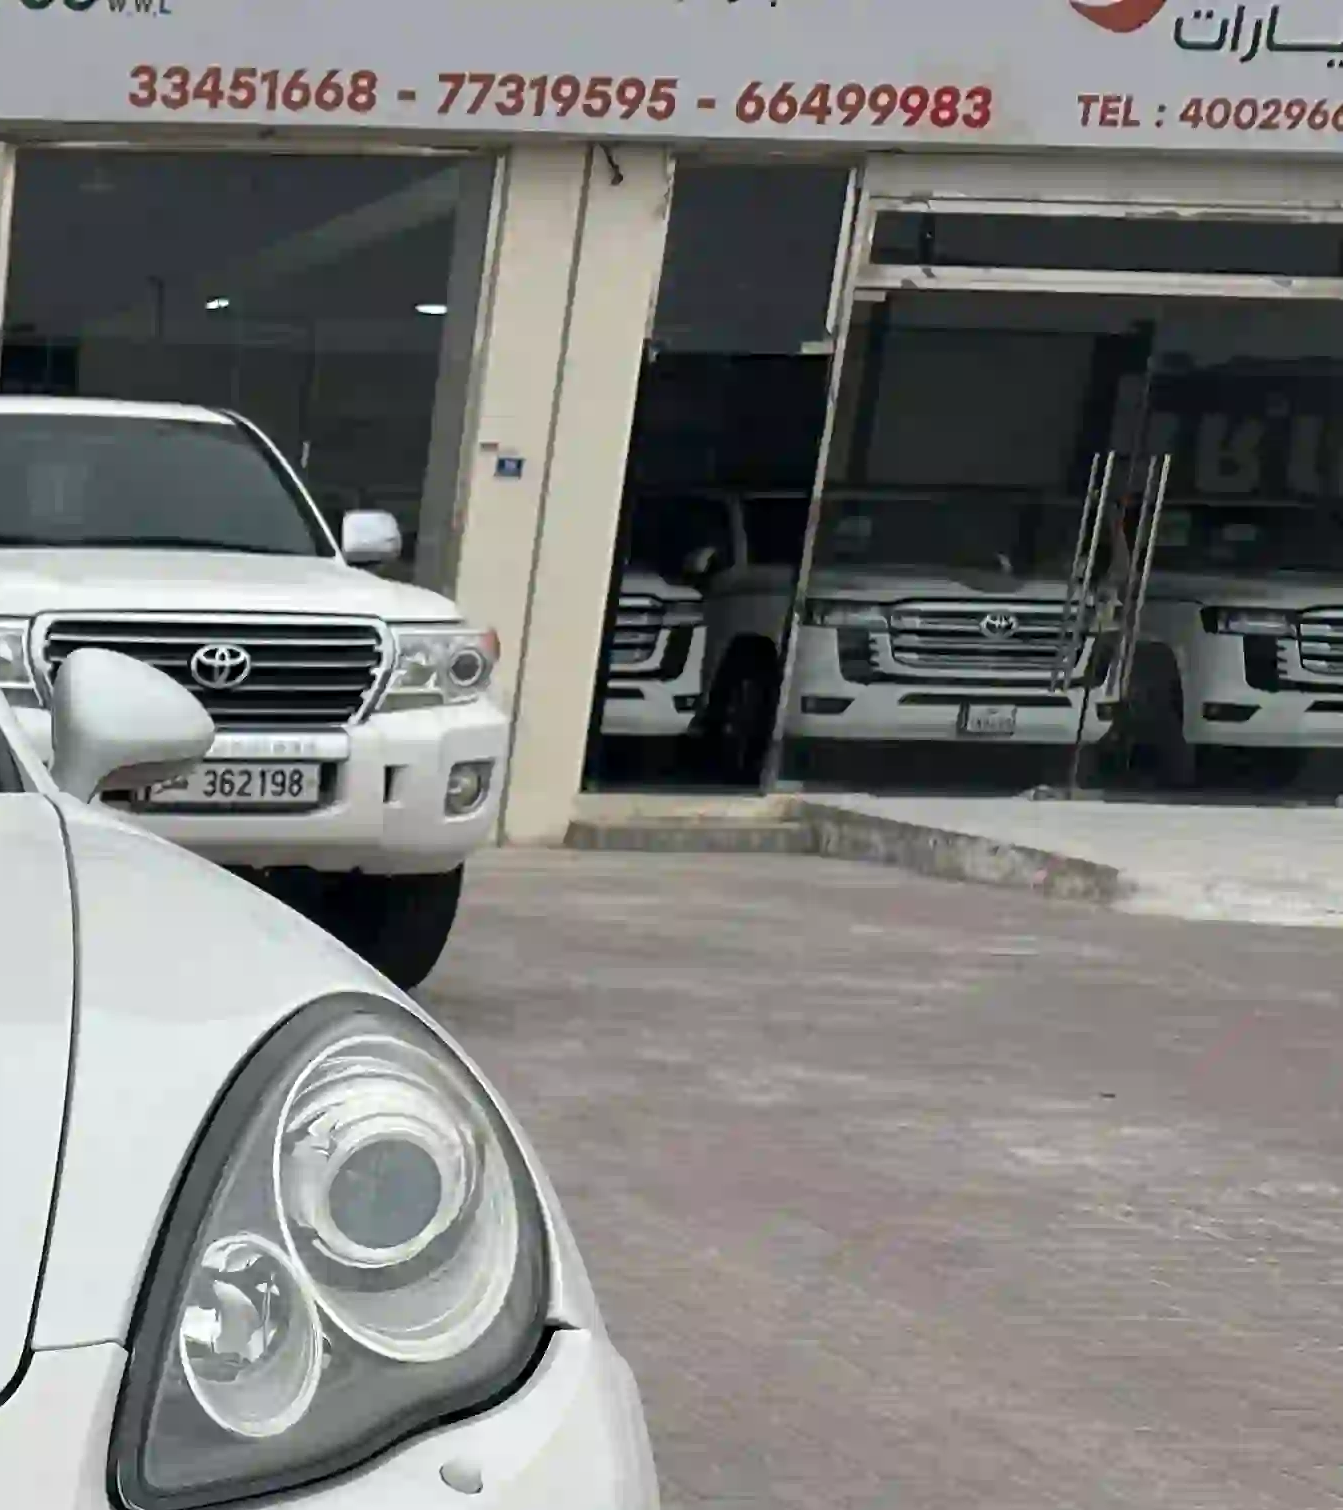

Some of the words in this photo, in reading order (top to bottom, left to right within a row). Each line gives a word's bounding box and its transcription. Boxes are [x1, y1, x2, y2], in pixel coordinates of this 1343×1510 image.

[128, 64, 378, 113] 33451668
[436, 72, 679, 121] 77319595
[735, 80, 993, 129] 66499983
[1077, 94, 1140, 128] TEL
[202, 769, 304, 798] 362198
